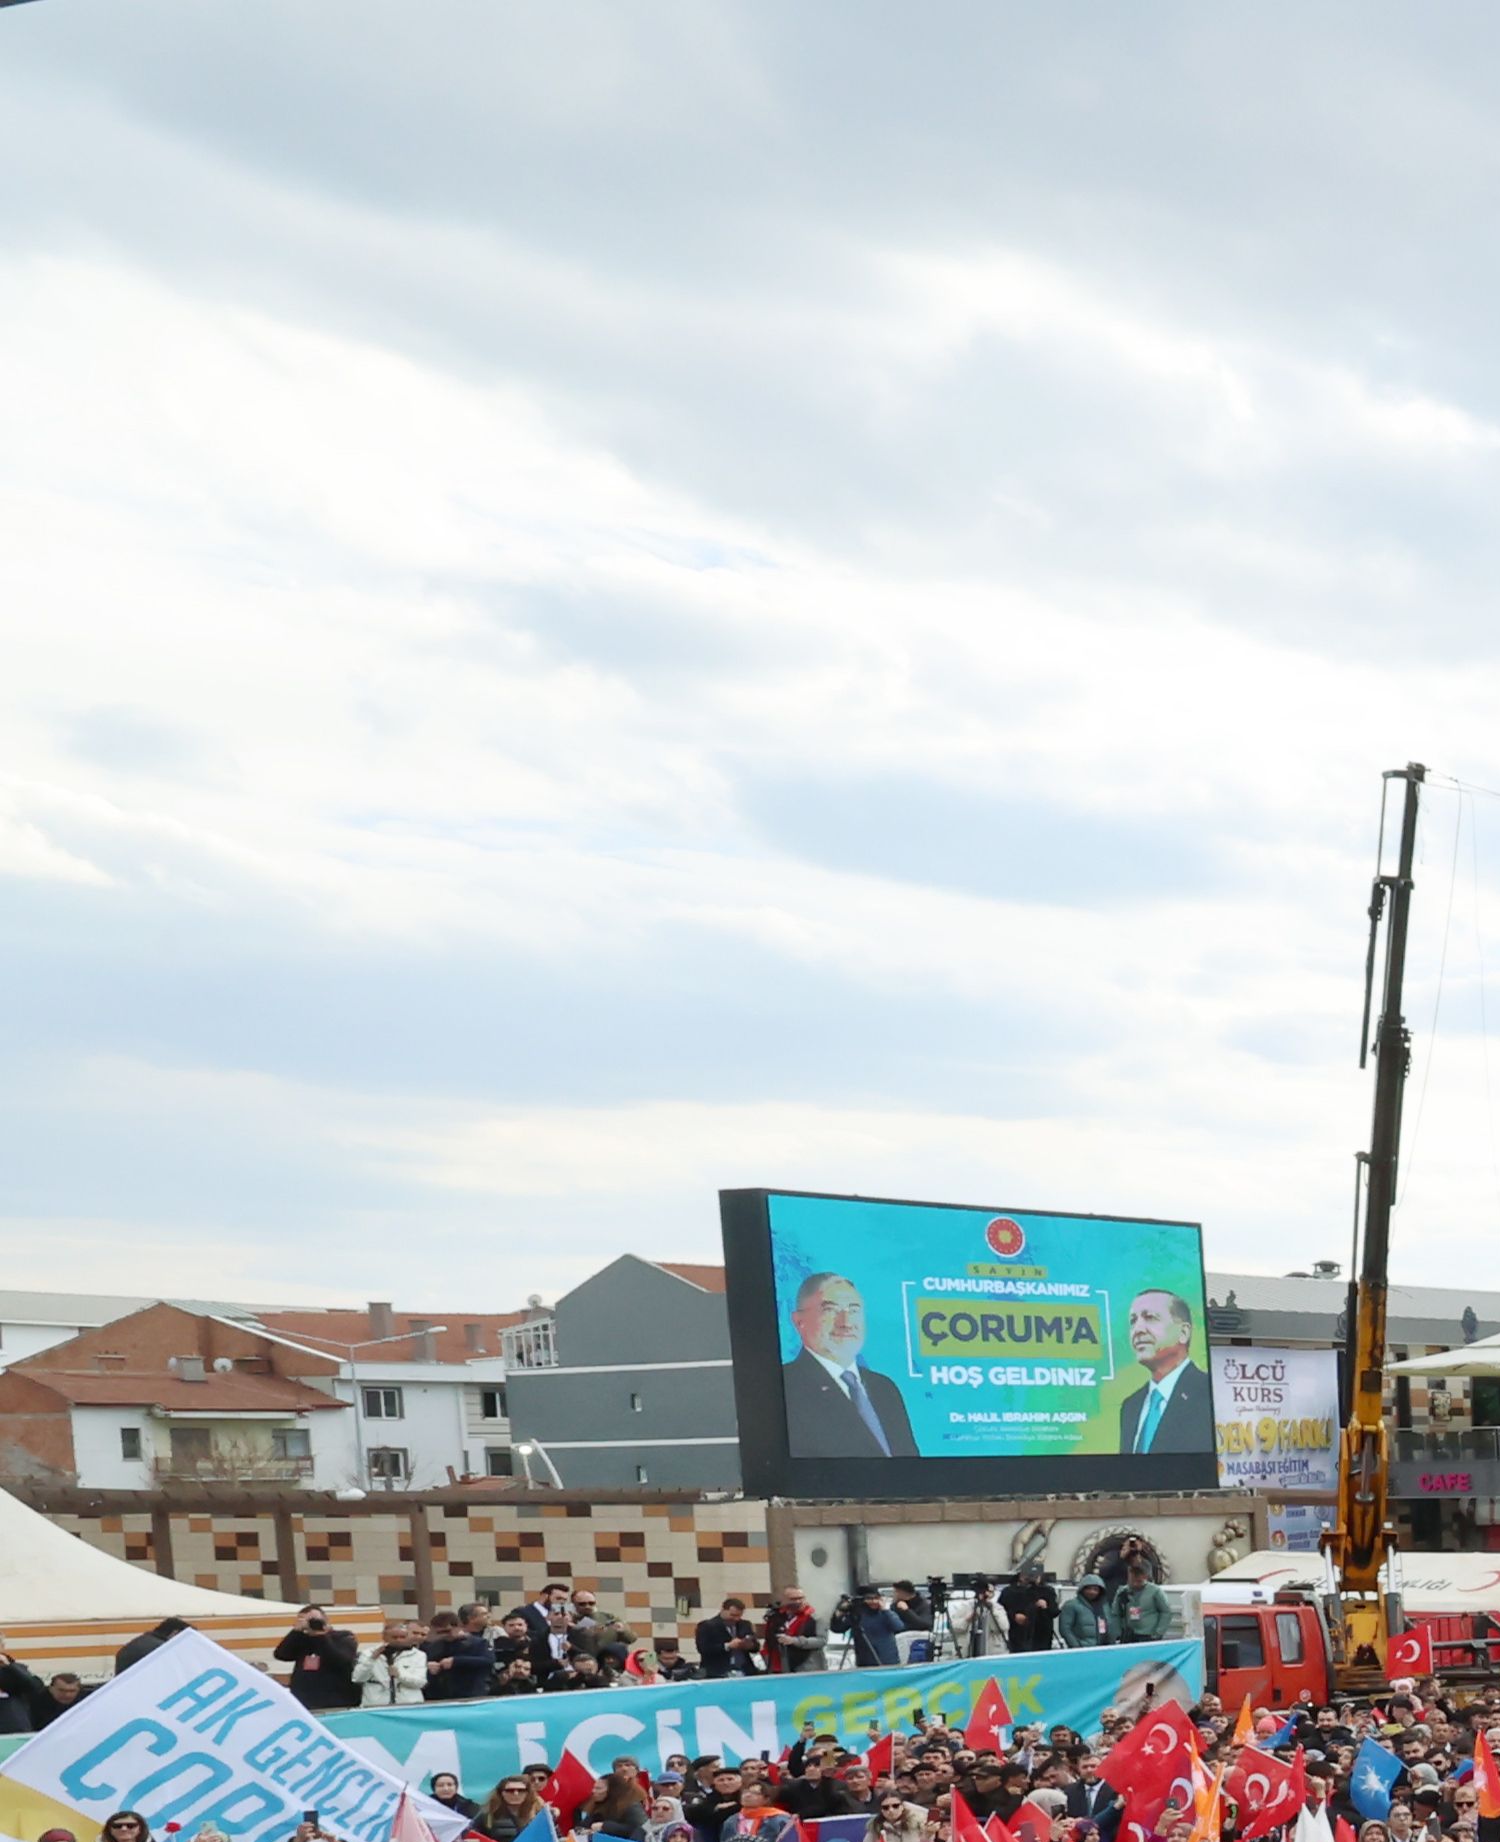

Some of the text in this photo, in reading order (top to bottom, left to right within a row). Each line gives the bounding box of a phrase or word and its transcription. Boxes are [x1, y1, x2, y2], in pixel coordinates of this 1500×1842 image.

[922, 1276, 1091, 1298] CUMHURBAŞKANIMIZ
[920, 1311, 1099, 1347] ÇORUM'A
[929, 1365, 1097, 1389] HOŞ GELDİNİZ
[1232, 1386, 1285, 1404] KURS
[1418, 1471, 1472, 1493] CAFE
[157, 1667, 275, 1747] AK
